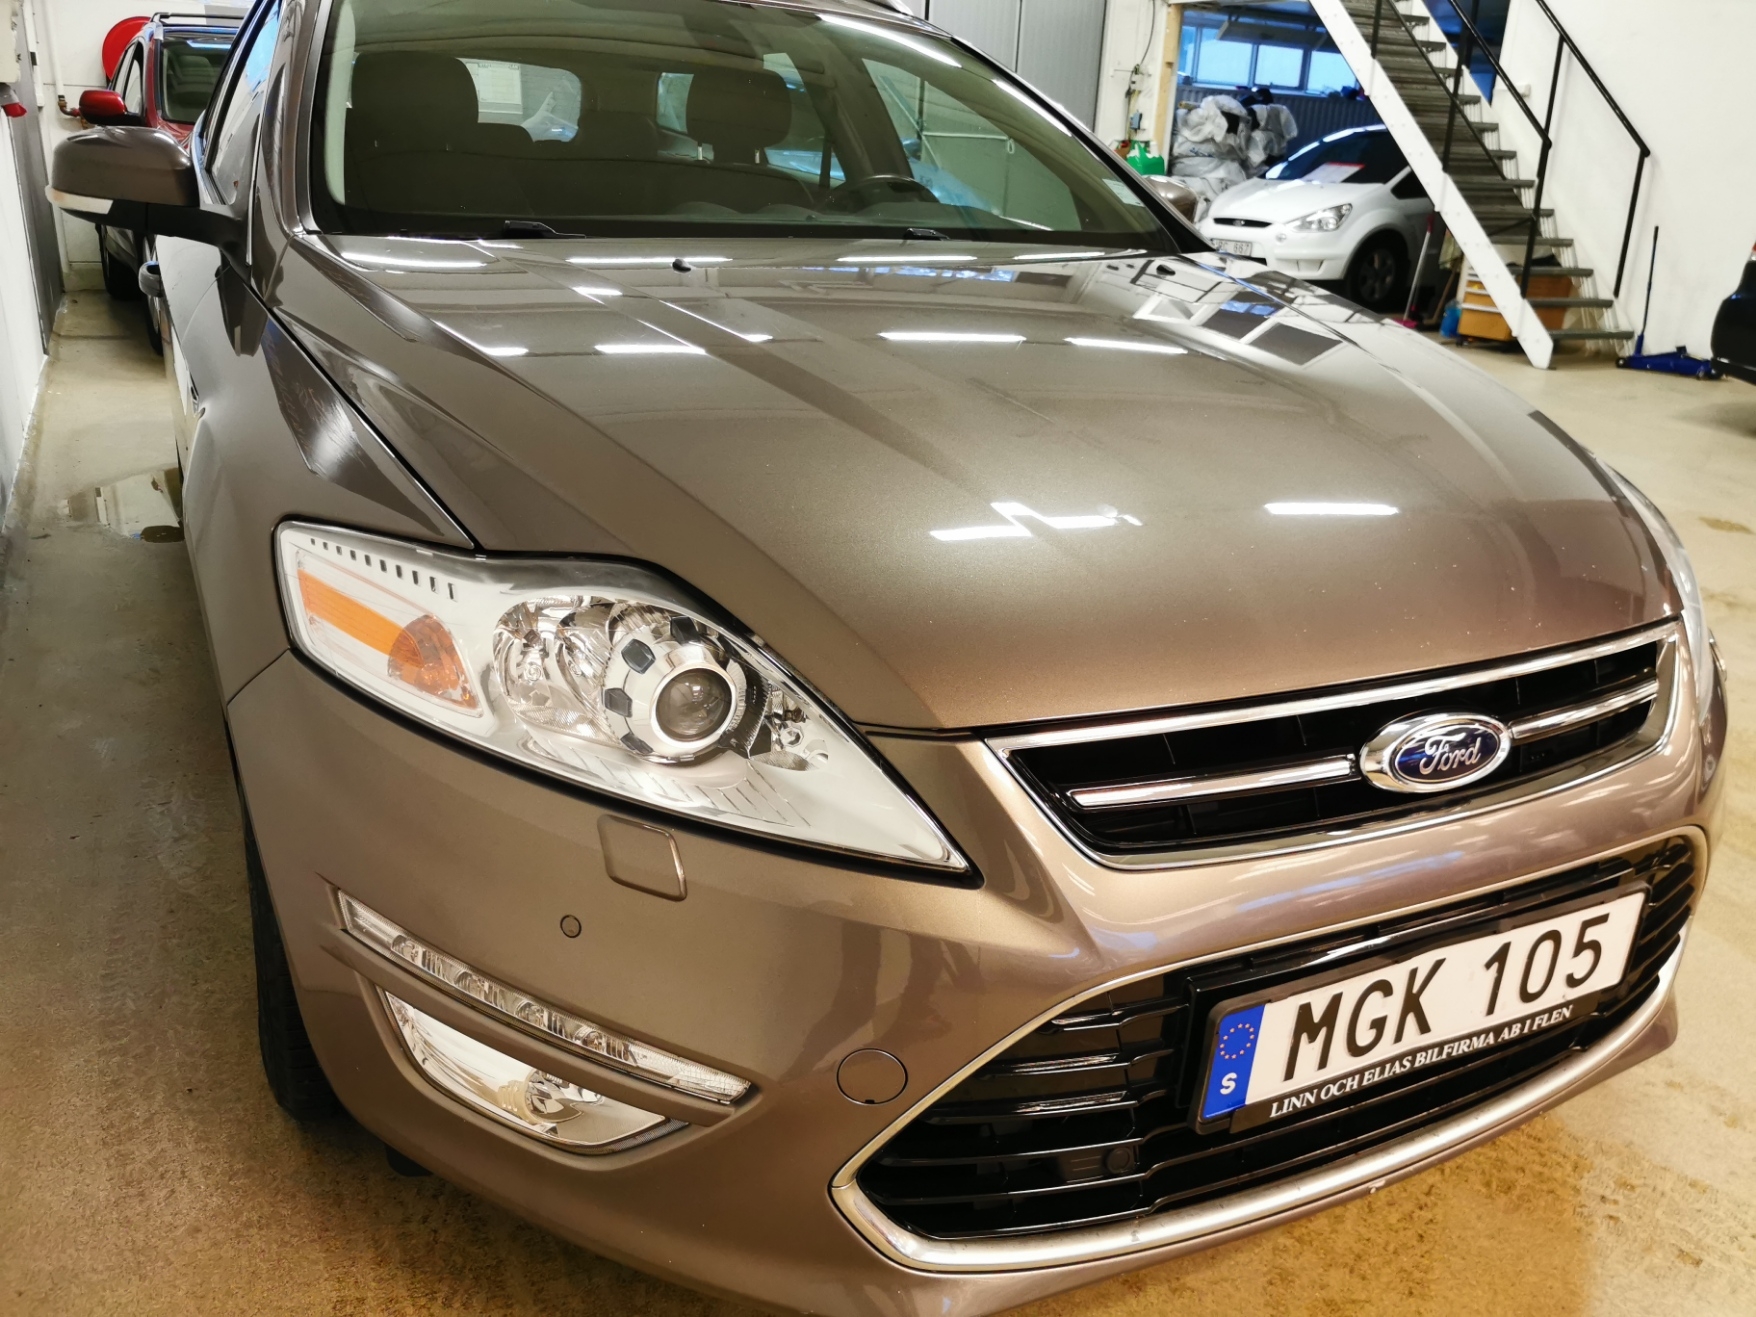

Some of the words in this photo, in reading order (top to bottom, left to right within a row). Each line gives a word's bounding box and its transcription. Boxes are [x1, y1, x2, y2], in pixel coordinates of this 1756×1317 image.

[1419, 732, 1482, 775] Ford
[1283, 957, 1447, 1082] MGK
[1484, 912, 1611, 1017] 105
[1220, 1072, 1238, 1095] S
[1269, 1089, 1318, 1118] LINN
[1320, 1074, 1359, 1100] OCH
[1361, 1054, 1413, 1086] ELIAS
[1413, 1031, 1496, 1068] BILFIRMA
[1497, 1022, 1523, 1042] AB
[1522, 1020, 1532, 1034] I
[1532, 1004, 1574, 1031] FLEN
